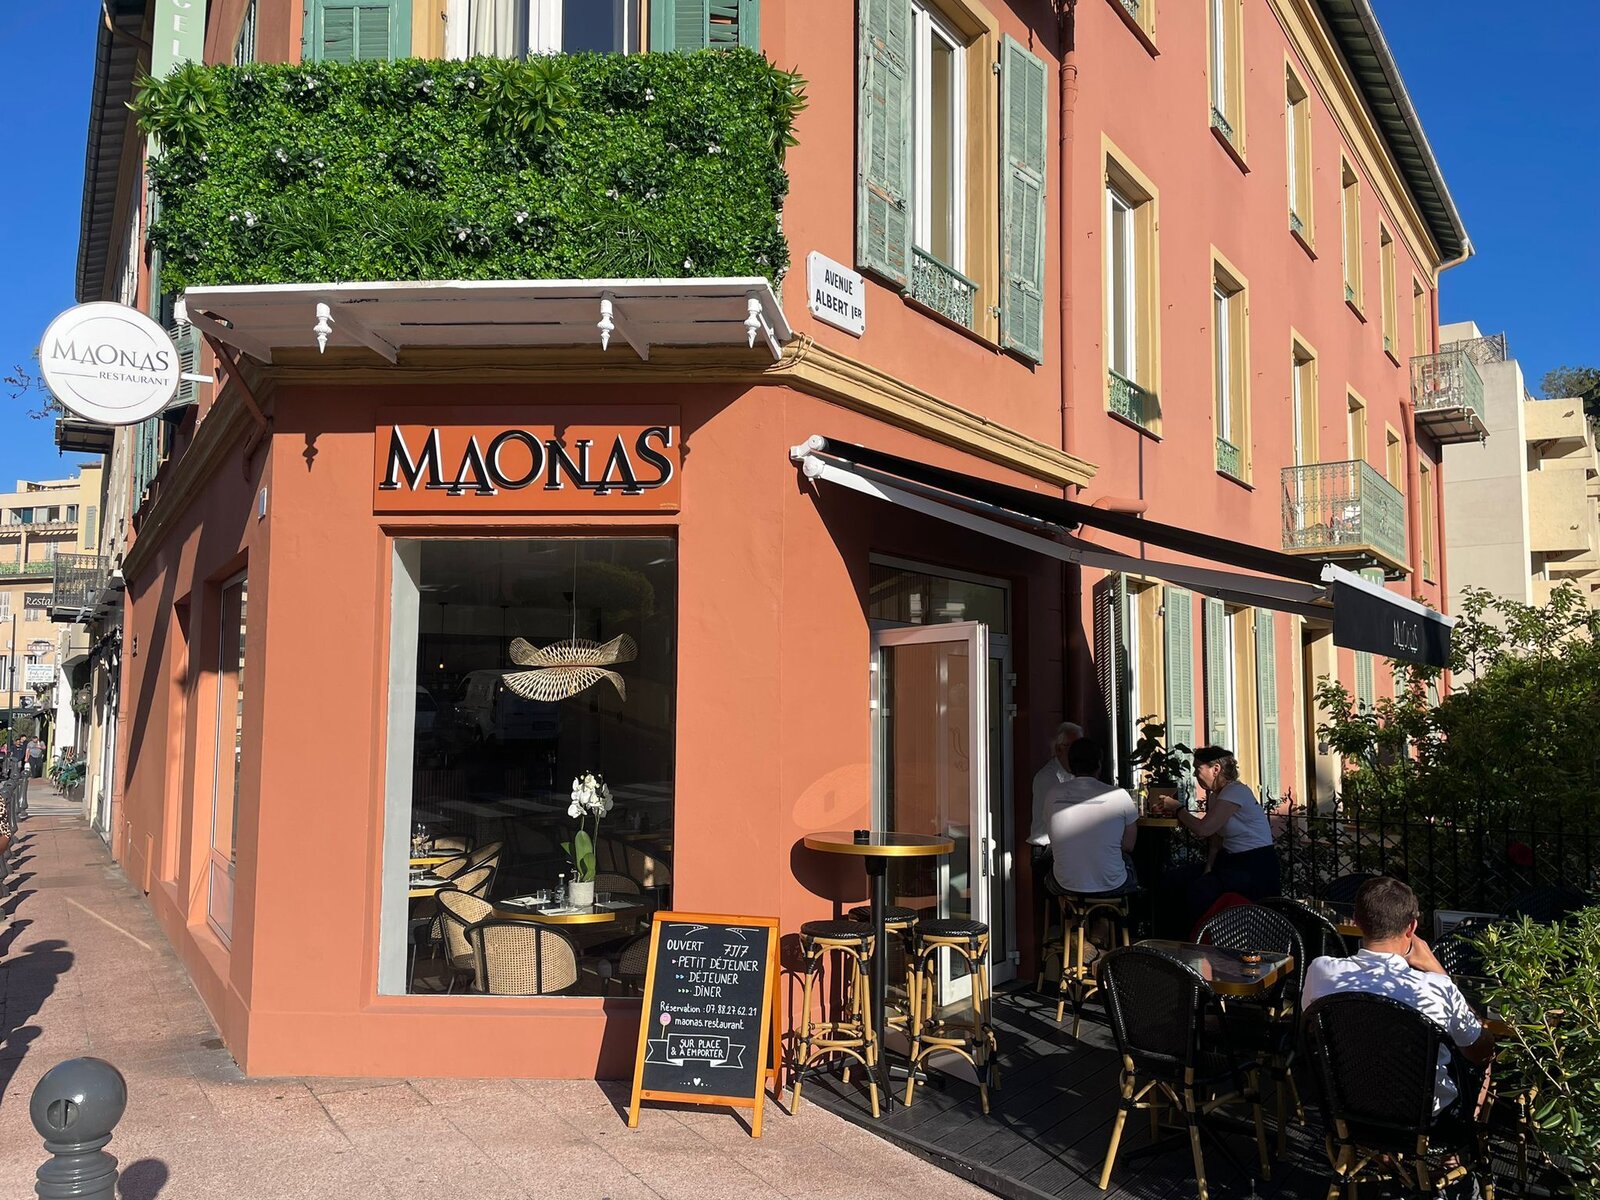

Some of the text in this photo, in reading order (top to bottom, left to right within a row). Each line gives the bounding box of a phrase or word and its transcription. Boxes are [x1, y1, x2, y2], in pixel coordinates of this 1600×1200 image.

[824, 269, 853, 296] AVENUE
[815, 288, 848, 317] ALBERT
[50, 337, 169, 372] MAONAS
[99, 371, 170, 386] RESTAURANT
[378, 424, 674, 496] MAONAS
[666, 939, 749, 957] OUVERT 7J/7
[710, 956, 759, 971] DÉJEUNER
[688, 970, 739, 984] DÉJEUNER
[693, 986, 722, 997] DÎNER
[660, 1001, 701, 1013] Réservation
[680, 1039, 721, 1049] SUR PLACE
[670, 1046, 677, 1056] &
[686, 1048, 724, 1058] EMPORTER
